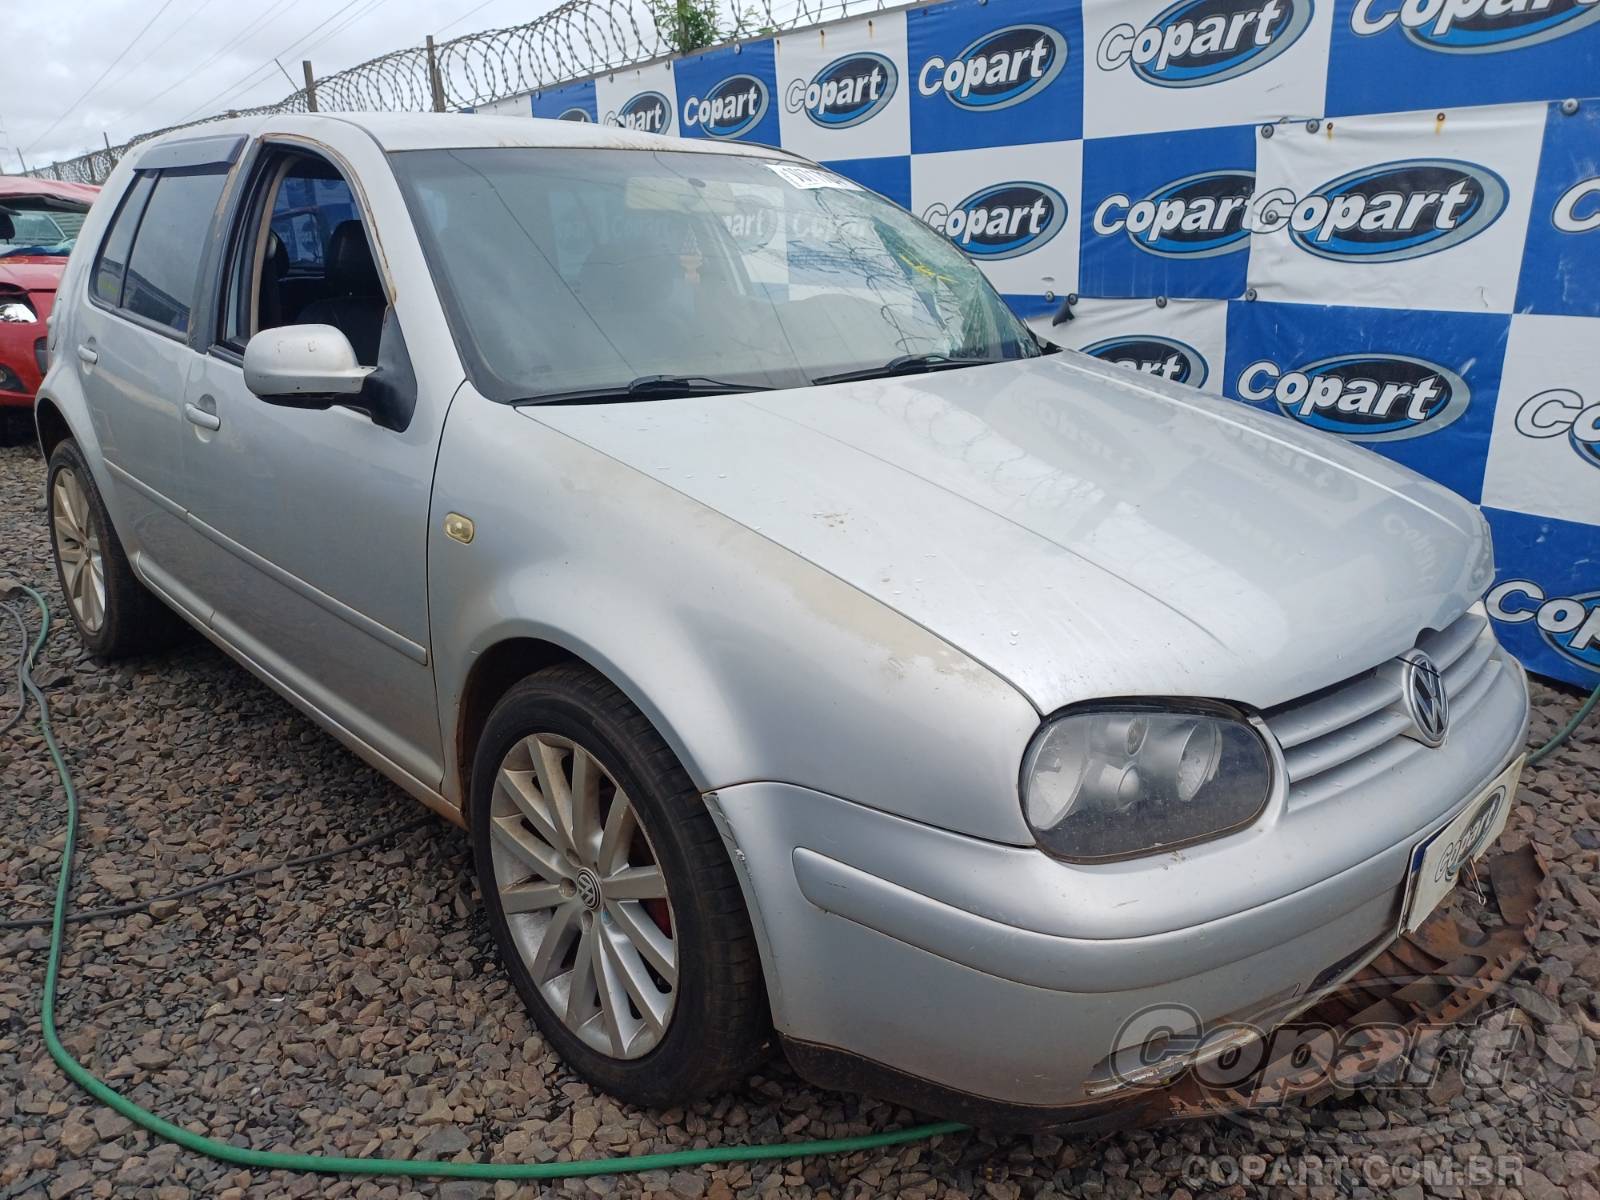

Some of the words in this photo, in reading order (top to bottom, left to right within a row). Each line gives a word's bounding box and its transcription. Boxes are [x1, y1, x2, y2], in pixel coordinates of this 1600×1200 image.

[918, 32, 1048, 97] Copart
[1096, 0, 1284, 71] Copart
[684, 83, 759, 128] Copart
[785, 64, 882, 115] Copart
[922, 194, 1048, 244] Copart
[1250, 176, 1473, 242] Copart
[1236, 360, 1443, 421] Copart
